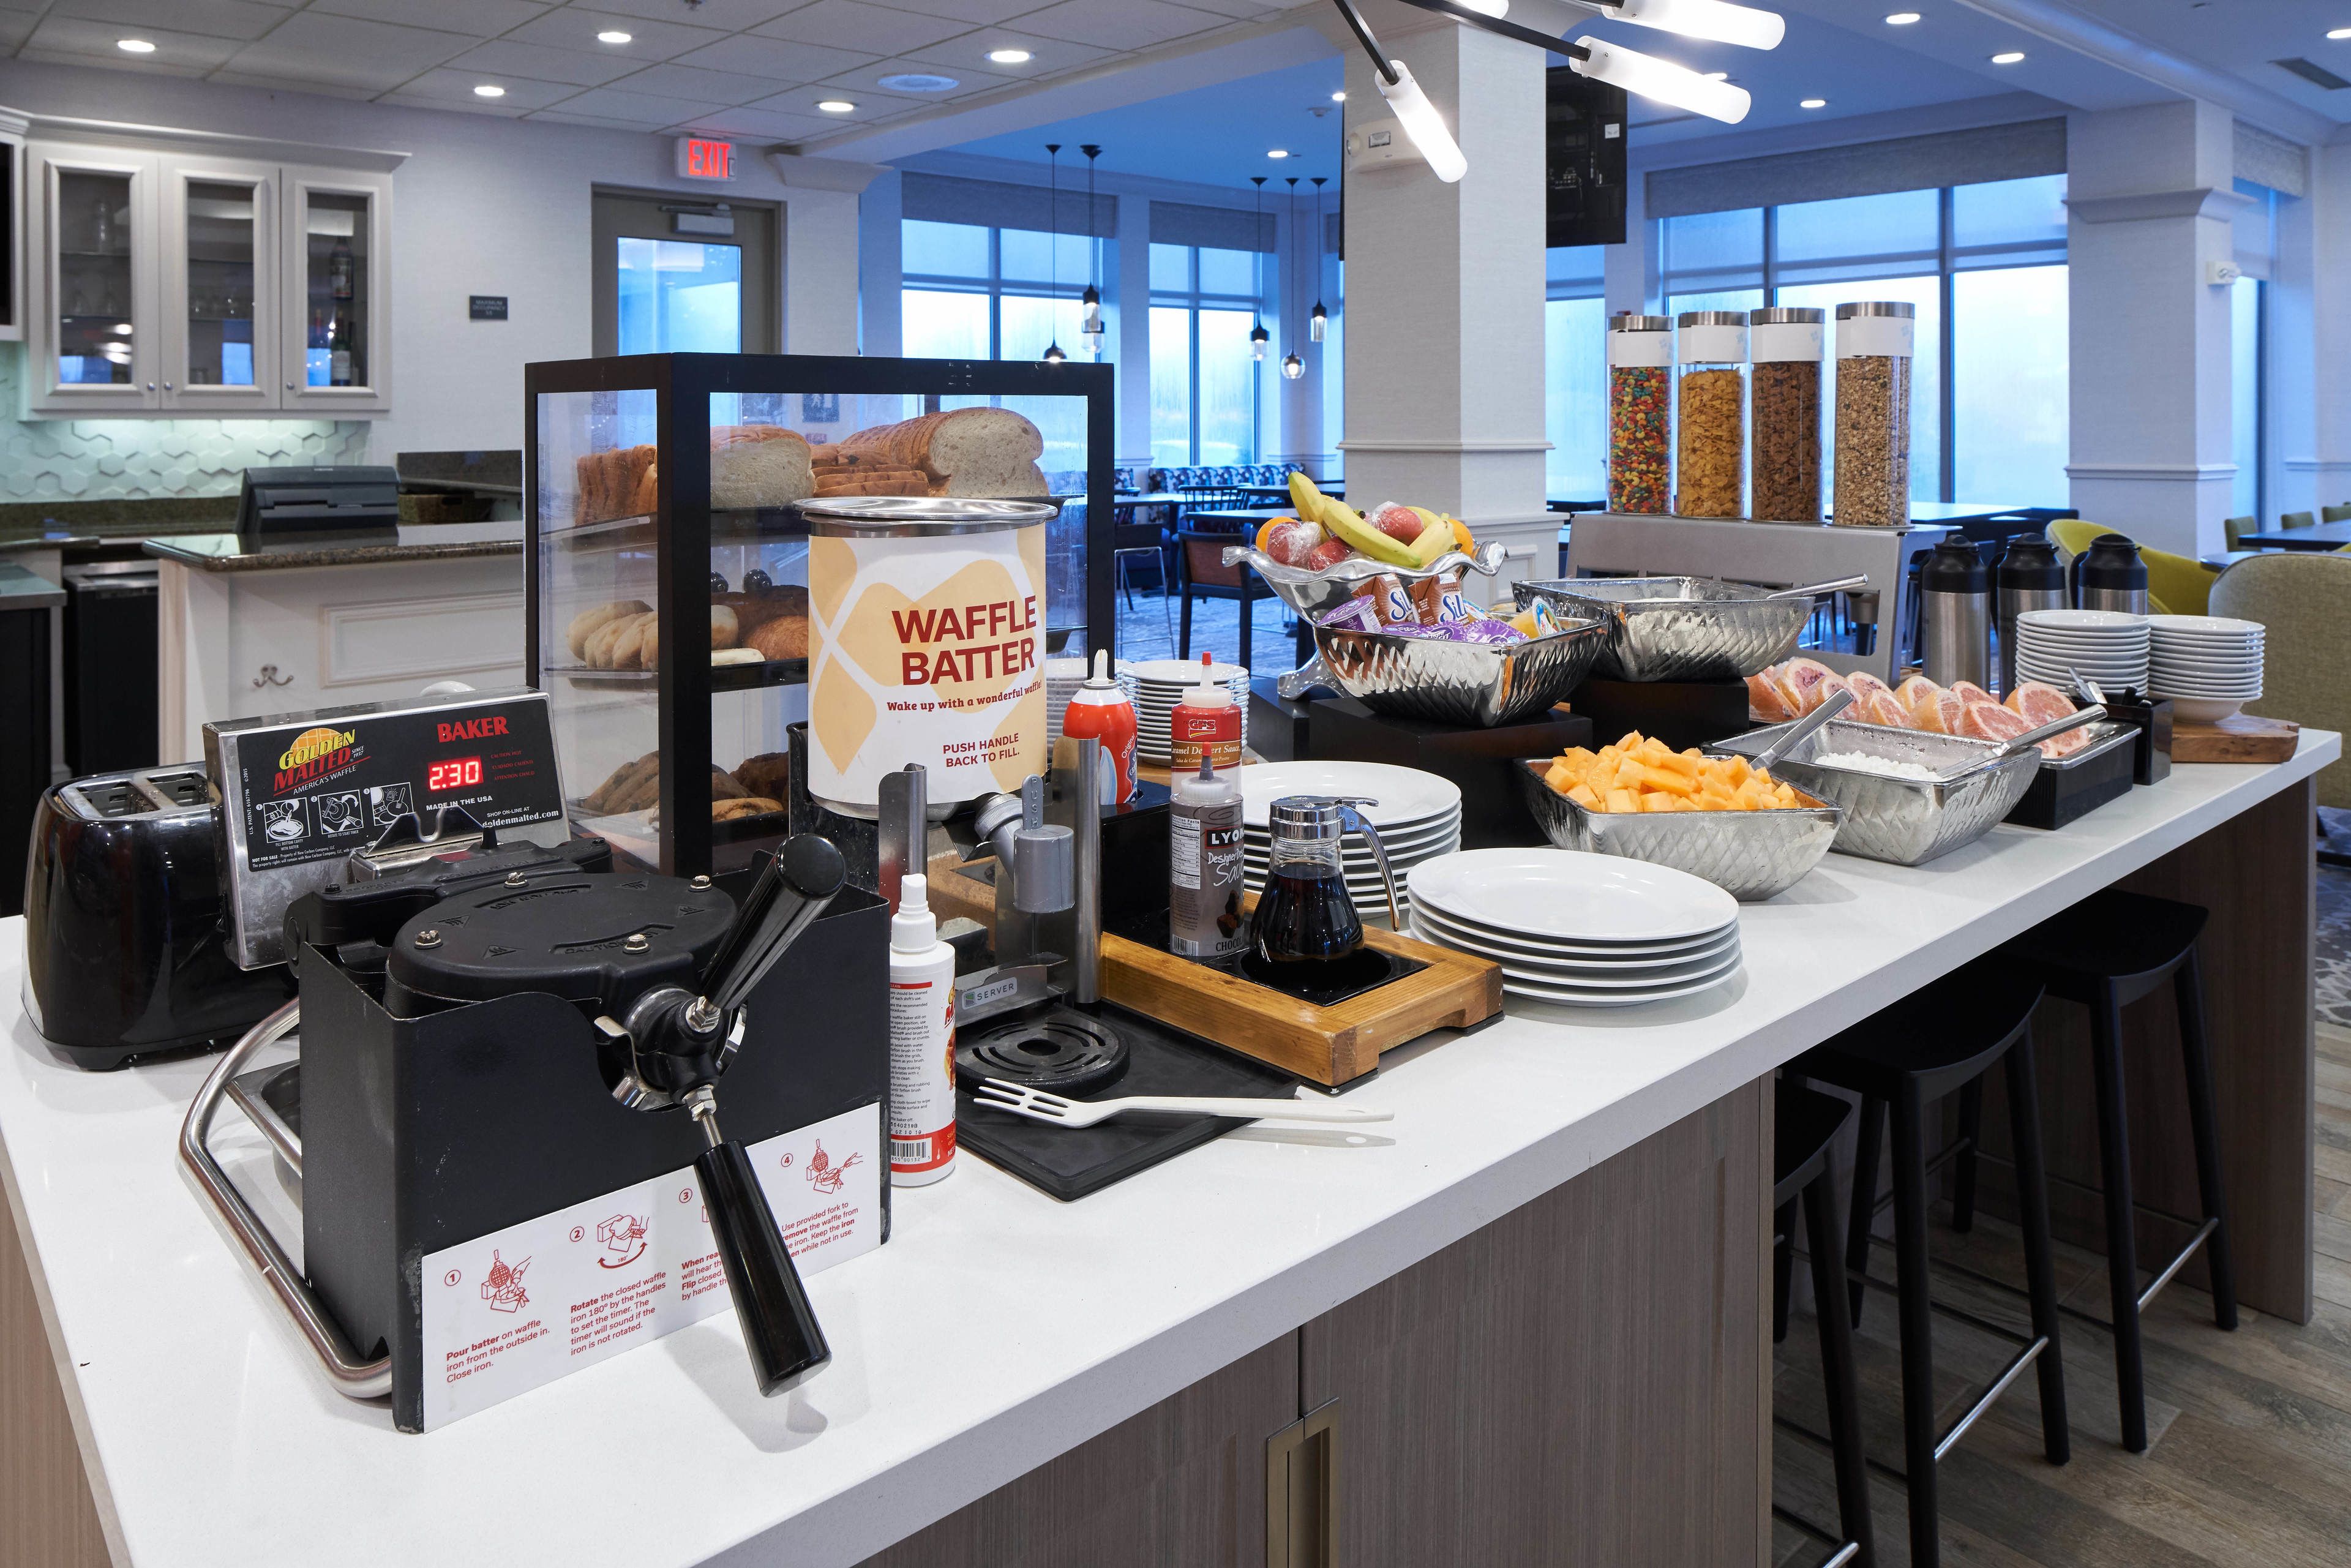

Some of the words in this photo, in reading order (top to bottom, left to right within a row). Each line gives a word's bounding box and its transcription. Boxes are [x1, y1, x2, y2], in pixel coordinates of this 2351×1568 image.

[688, 140, 732, 179] EXIT
[891, 595, 1037, 643] WAFFLE
[1390, 591, 1412, 620] Sil
[902, 637, 1035, 686] BATTER
[887, 702, 917, 711] Wake
[921, 702, 934, 711] up
[938, 697, 964, 709] with
[977, 687, 1023, 705] wonderful
[1024, 680, 1042, 694] waffle!
[437, 716, 509, 743] BAKER
[1189, 719, 1216, 730] GFS
[279, 729, 355, 770] GOLDEN
[351, 746, 364, 754] SINCE
[943, 742, 975, 754] PUSH
[980, 733, 1019, 750] HANDLE
[946, 756, 978, 767] BACK
[981, 752, 996, 763] TO
[999, 747, 1020, 759] FILL.
[1122, 732, 1135, 758] Original
[1191, 746, 1221, 754] Deert
[274, 747, 351, 791] MALTED
[293, 776, 328, 795] AMERICA'S
[330, 765, 356, 779] WAFFLE
[429, 761, 479, 790] 2:30
[426, 802, 448, 811] MADE
[1211, 828, 1244, 844] LYON
[1213, 863, 1244, 887] Sauc
[1216, 937, 1243, 951] CHOCOL
[977, 983, 1014, 1000] SERVER
[781, 1223, 795, 1232] Use
[797, 1210, 825, 1228] provided
[828, 1206, 840, 1215] fork
[782, 1227, 808, 1240] remove
[809, 1222, 820, 1231] the
[822, 1214, 841, 1226] waffle
[843, 1207, 858, 1218] from
[795, 1236, 809, 1247] iron.
[811, 1229, 828, 1240] Keep
[829, 1223, 840, 1232] the
[841, 1218, 855, 1228] iron
[801, 1242, 819, 1253] while
[820, 1237, 831, 1245] not
[840, 1229, 853, 1239] use.
[681, 1258, 704, 1270] When
[706, 1251, 721, 1261] rea
[681, 1270, 694, 1280] will
[696, 1264, 711, 1275] hear
[714, 1259, 722, 1268] th
[571, 1298, 599, 1313] Rotate
[601, 1292, 613, 1302] the
[615, 1280, 641, 1296] closed
[643, 1271, 666, 1285] waffle
[682, 1280, 696, 1291] Flip
[698, 1269, 721, 1285] closed
[682, 1292, 691, 1301] by
[692, 1282, 718, 1297] handle
[571, 1314, 586, 1324] iron
[610, 1300, 620, 1309] by
[621, 1294, 634, 1305] the
[636, 1282, 666, 1299] handles
[571, 1326, 579, 1335] to
[582, 1321, 593, 1330] set
[596, 1315, 608, 1325] the
[610, 1306, 632, 1320] timer.
[634, 1299, 649, 1309] The
[571, 1331, 592, 1345] timer
[594, 1325, 607, 1335] will
[609, 1316, 634, 1330] sound
[643, 1306, 655, 1316] the
[447, 1347, 469, 1361] Pour
[471, 1335, 500, 1352] batter
[502, 1331, 512, 1340] on
[515, 1319, 541, 1335] waffle
[447, 1361, 464, 1372] iron
[466, 1352, 487, 1365] from
[490, 1345, 504, 1356] the
[506, 1334, 538, 1349] outside
[540, 1327, 550, 1336] in.
[571, 1345, 587, 1356] iron
[598, 1334, 611, 1345] not
[612, 1321, 643, 1339] rotated.
[447, 1368, 471, 1382] Close
[474, 1361, 493, 1373] iron.
